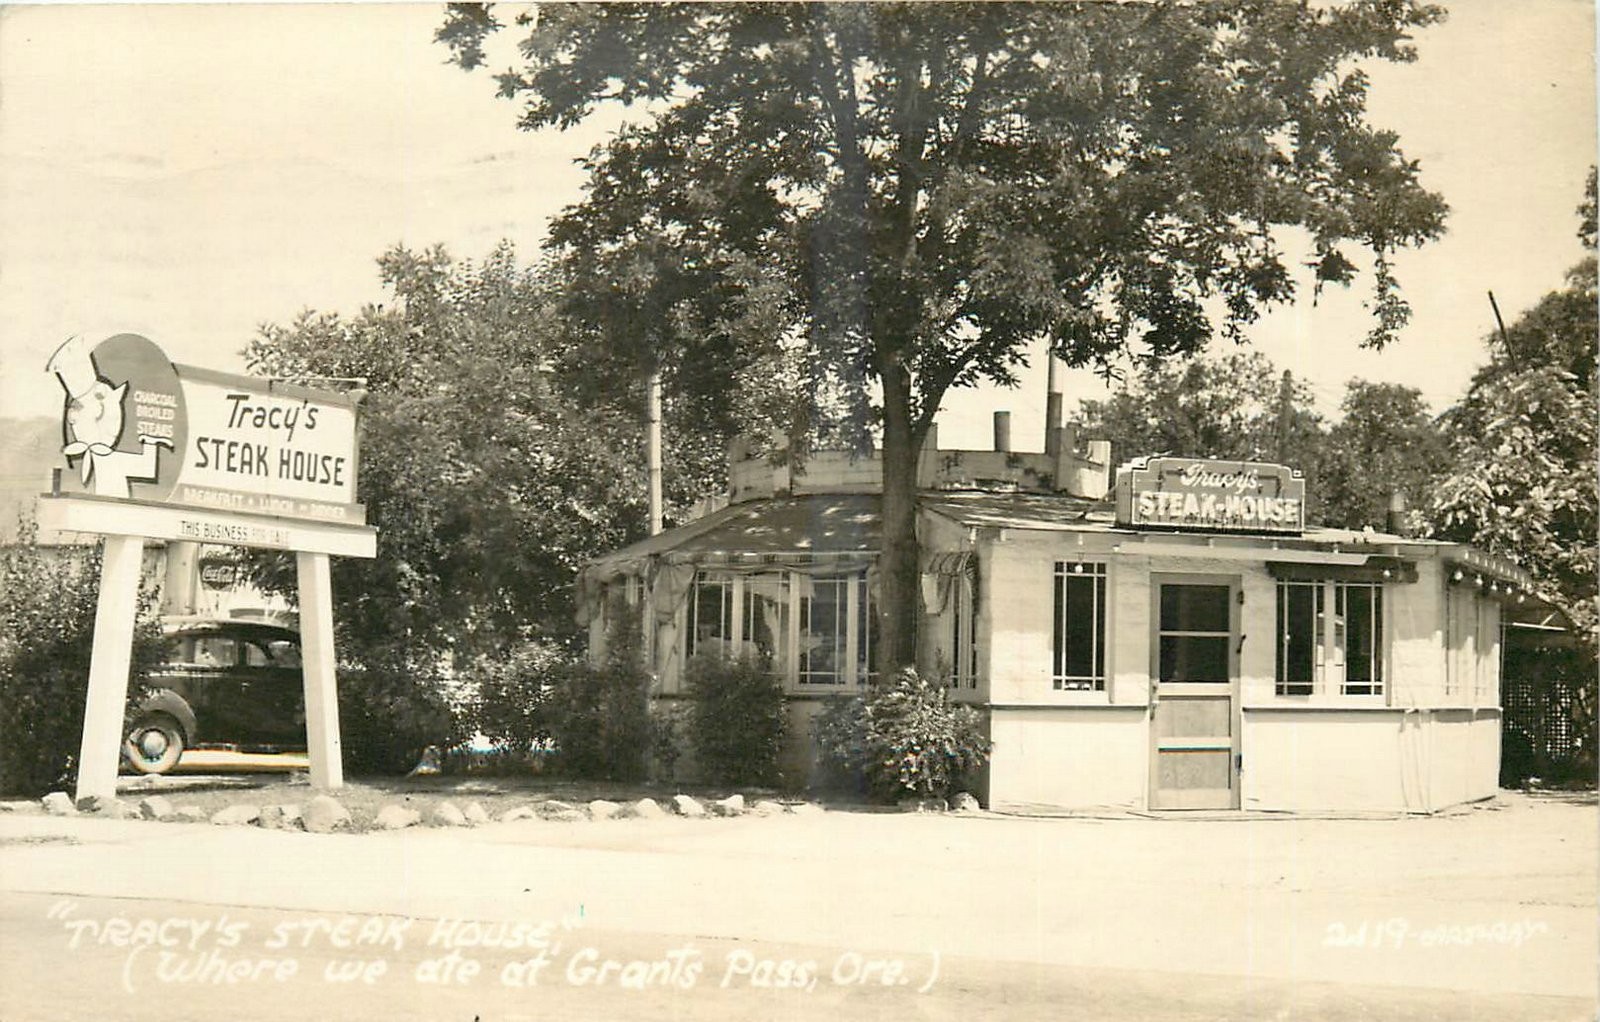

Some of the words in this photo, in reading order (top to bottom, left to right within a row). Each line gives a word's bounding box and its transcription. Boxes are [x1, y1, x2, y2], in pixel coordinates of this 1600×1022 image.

[136, 421, 174, 438] STEAKS
[226, 394, 319, 441] Tracy's
[195, 437, 269, 478] STEAK
[279, 449, 345, 487] HOUSE
[1180, 464, 1259, 494] Tracy's
[181, 520, 199, 537] THIS
[203, 523, 247, 541] BUSINESS
